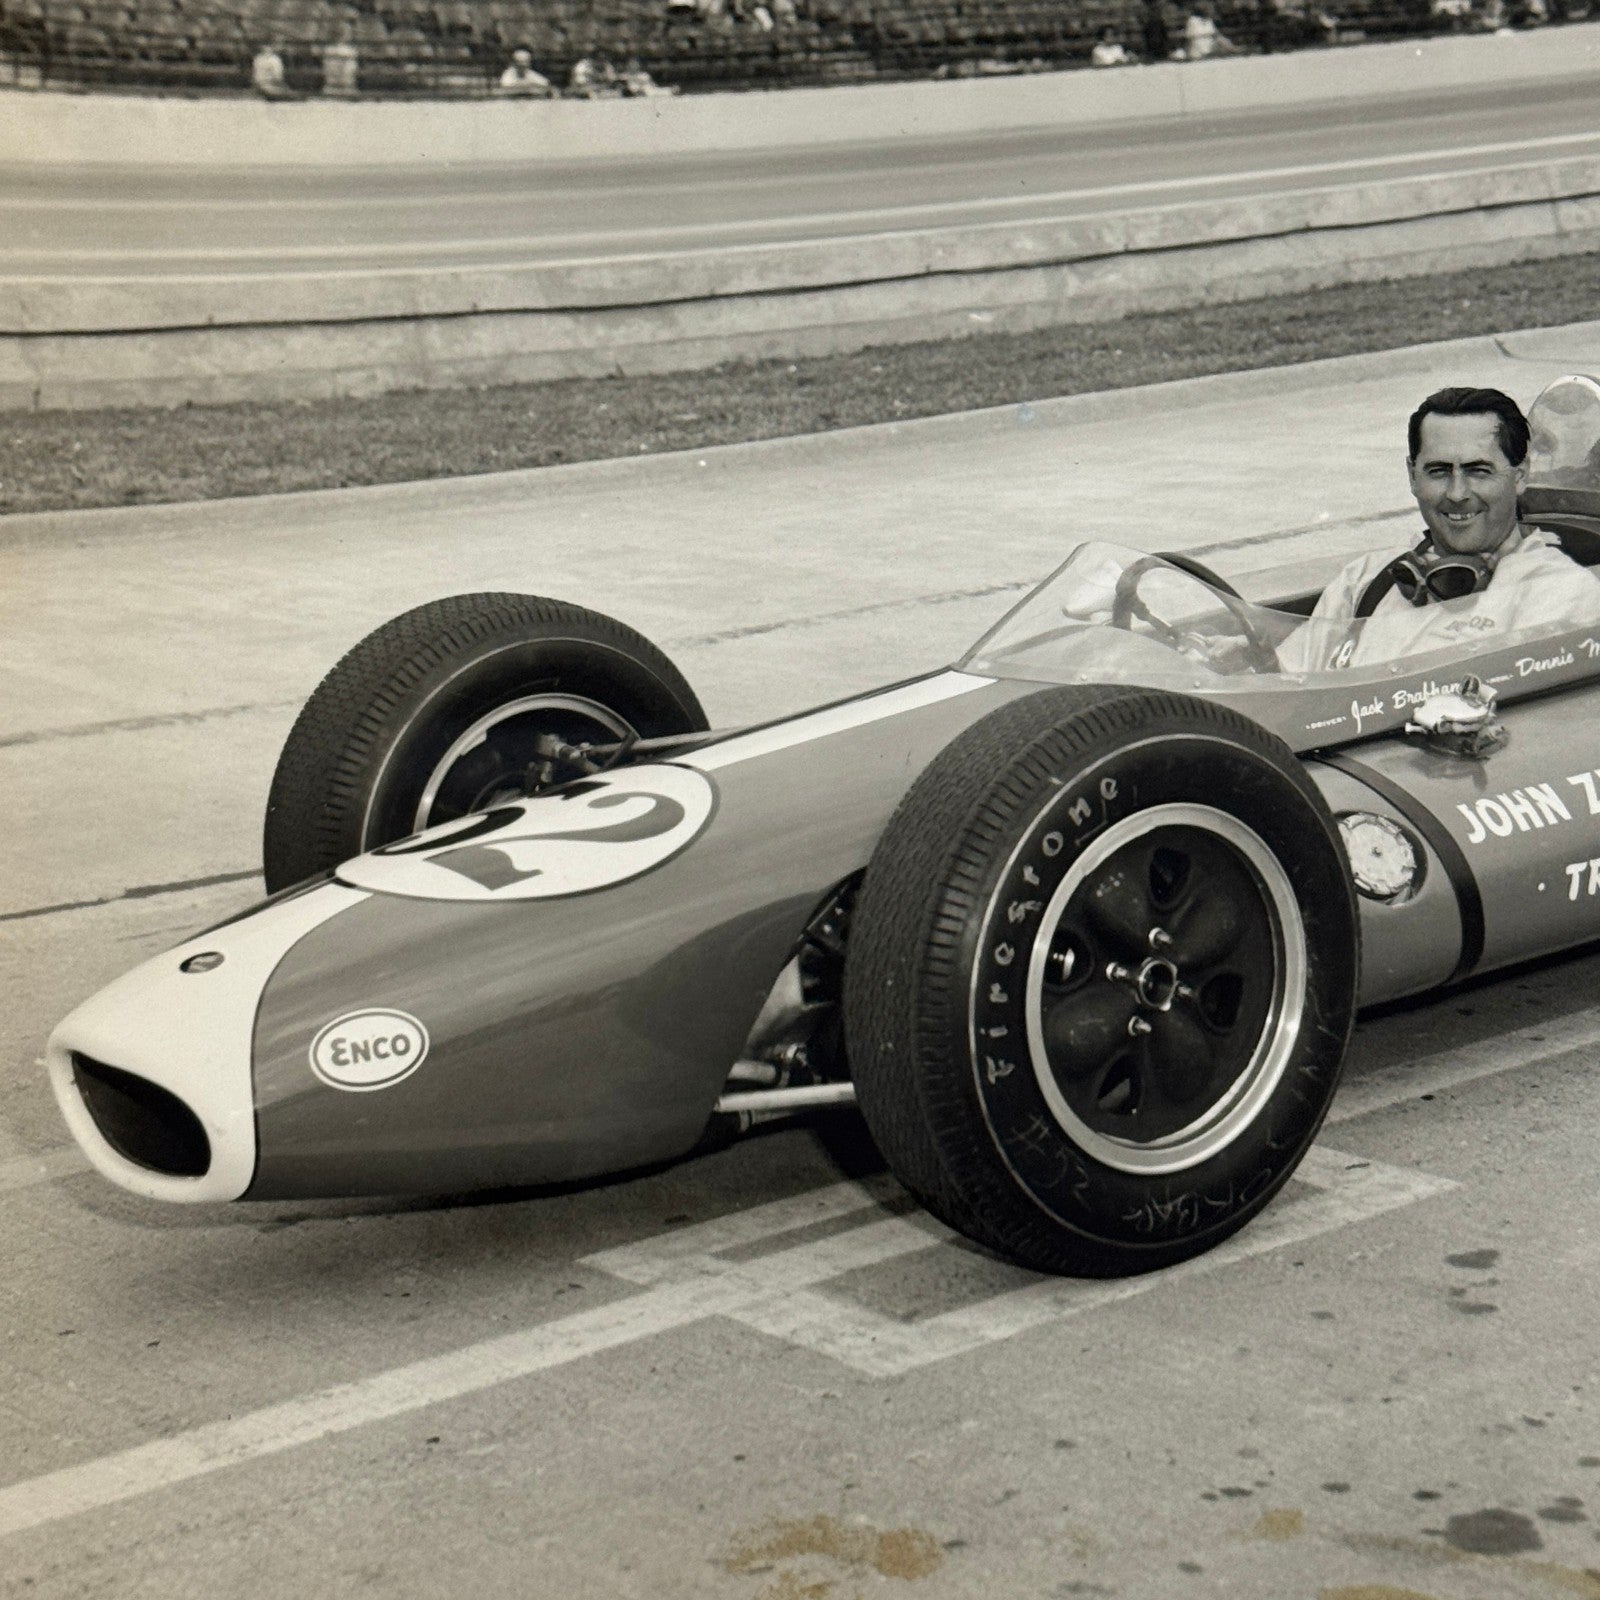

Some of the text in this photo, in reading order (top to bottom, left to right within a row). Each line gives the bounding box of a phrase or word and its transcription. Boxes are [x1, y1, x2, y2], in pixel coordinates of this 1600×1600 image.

[1350, 695, 1385, 734] Jack
[1456, 768, 1600, 844] JOHN Z
[330, 1033, 411, 1067] ENCO
